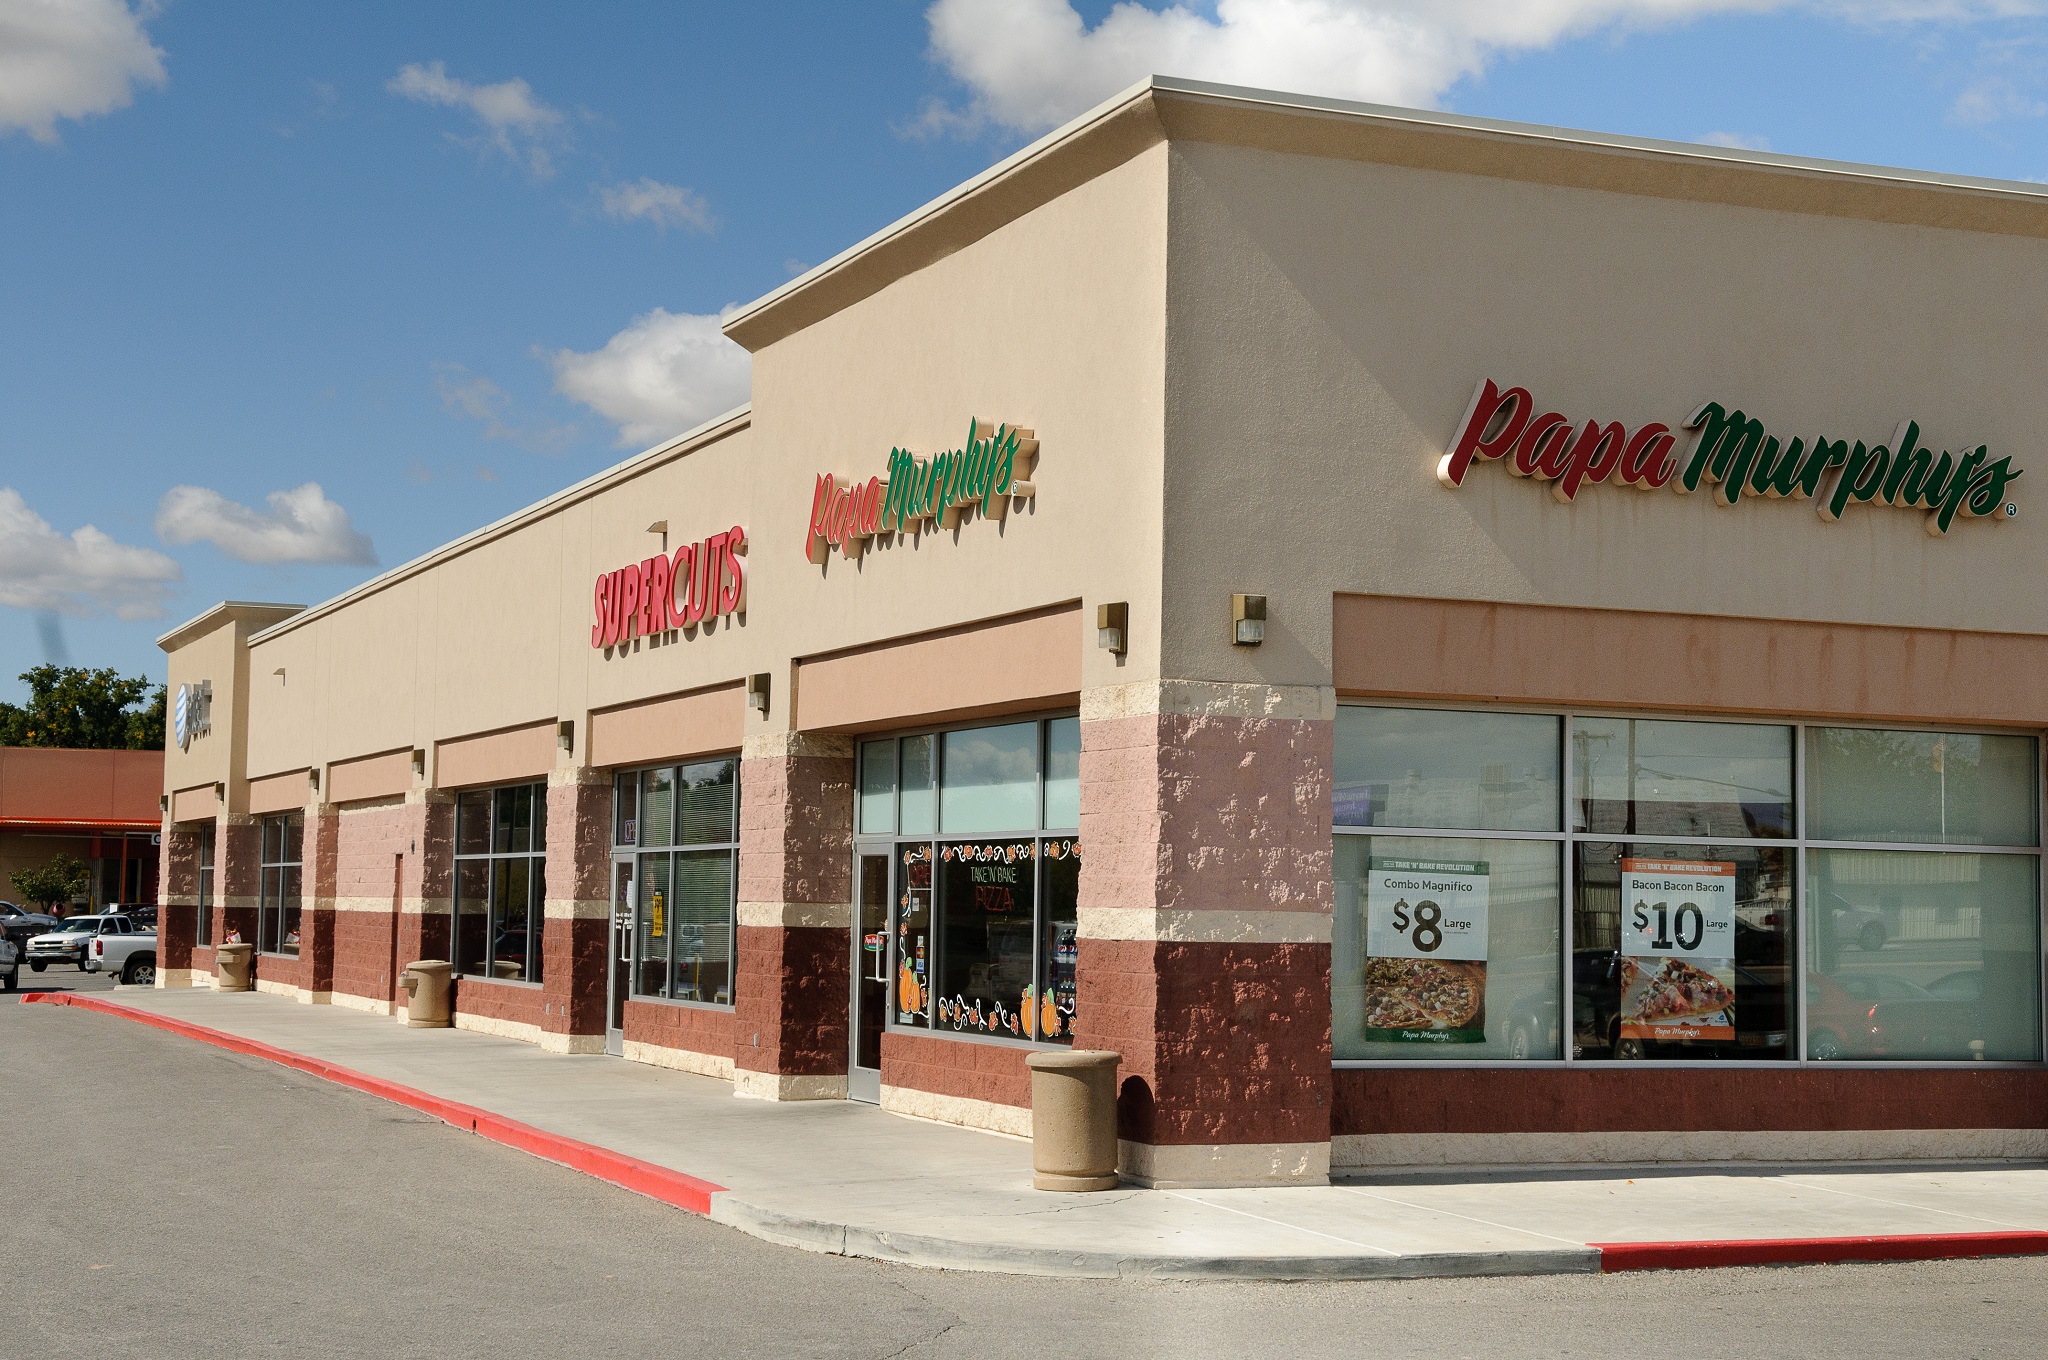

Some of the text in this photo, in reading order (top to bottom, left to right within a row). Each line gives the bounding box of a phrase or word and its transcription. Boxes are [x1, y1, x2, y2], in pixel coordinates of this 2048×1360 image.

[1440, 378, 2024, 534] Papa Murphy's
[806, 416, 1022, 564] Papa Murphy's
[592, 525, 746, 649] SUPERCUTS
[970, 866, 987, 882] TAKE
[998, 867, 1017, 884] BAKE
[1395, 861, 1410, 869] TAKE
[1419, 862, 1436, 870] BAKE
[1436, 863, 1475, 872] REVOLUTION
[1685, 865, 1722, 873] REVOLUTION
[1384, 878, 1473, 893] Combo Magnifico
[1632, 880, 1725, 892] Bacon Bacon Bacon
[976, 886, 1013, 912] PIZZA
[1392, 897, 1472, 953] $8 Large
[1632, 899, 1728, 951] $10 Large
[1402, 1030, 1450, 1041] Papa Murphy's
[1654, 1027, 1671, 1037] Papa
